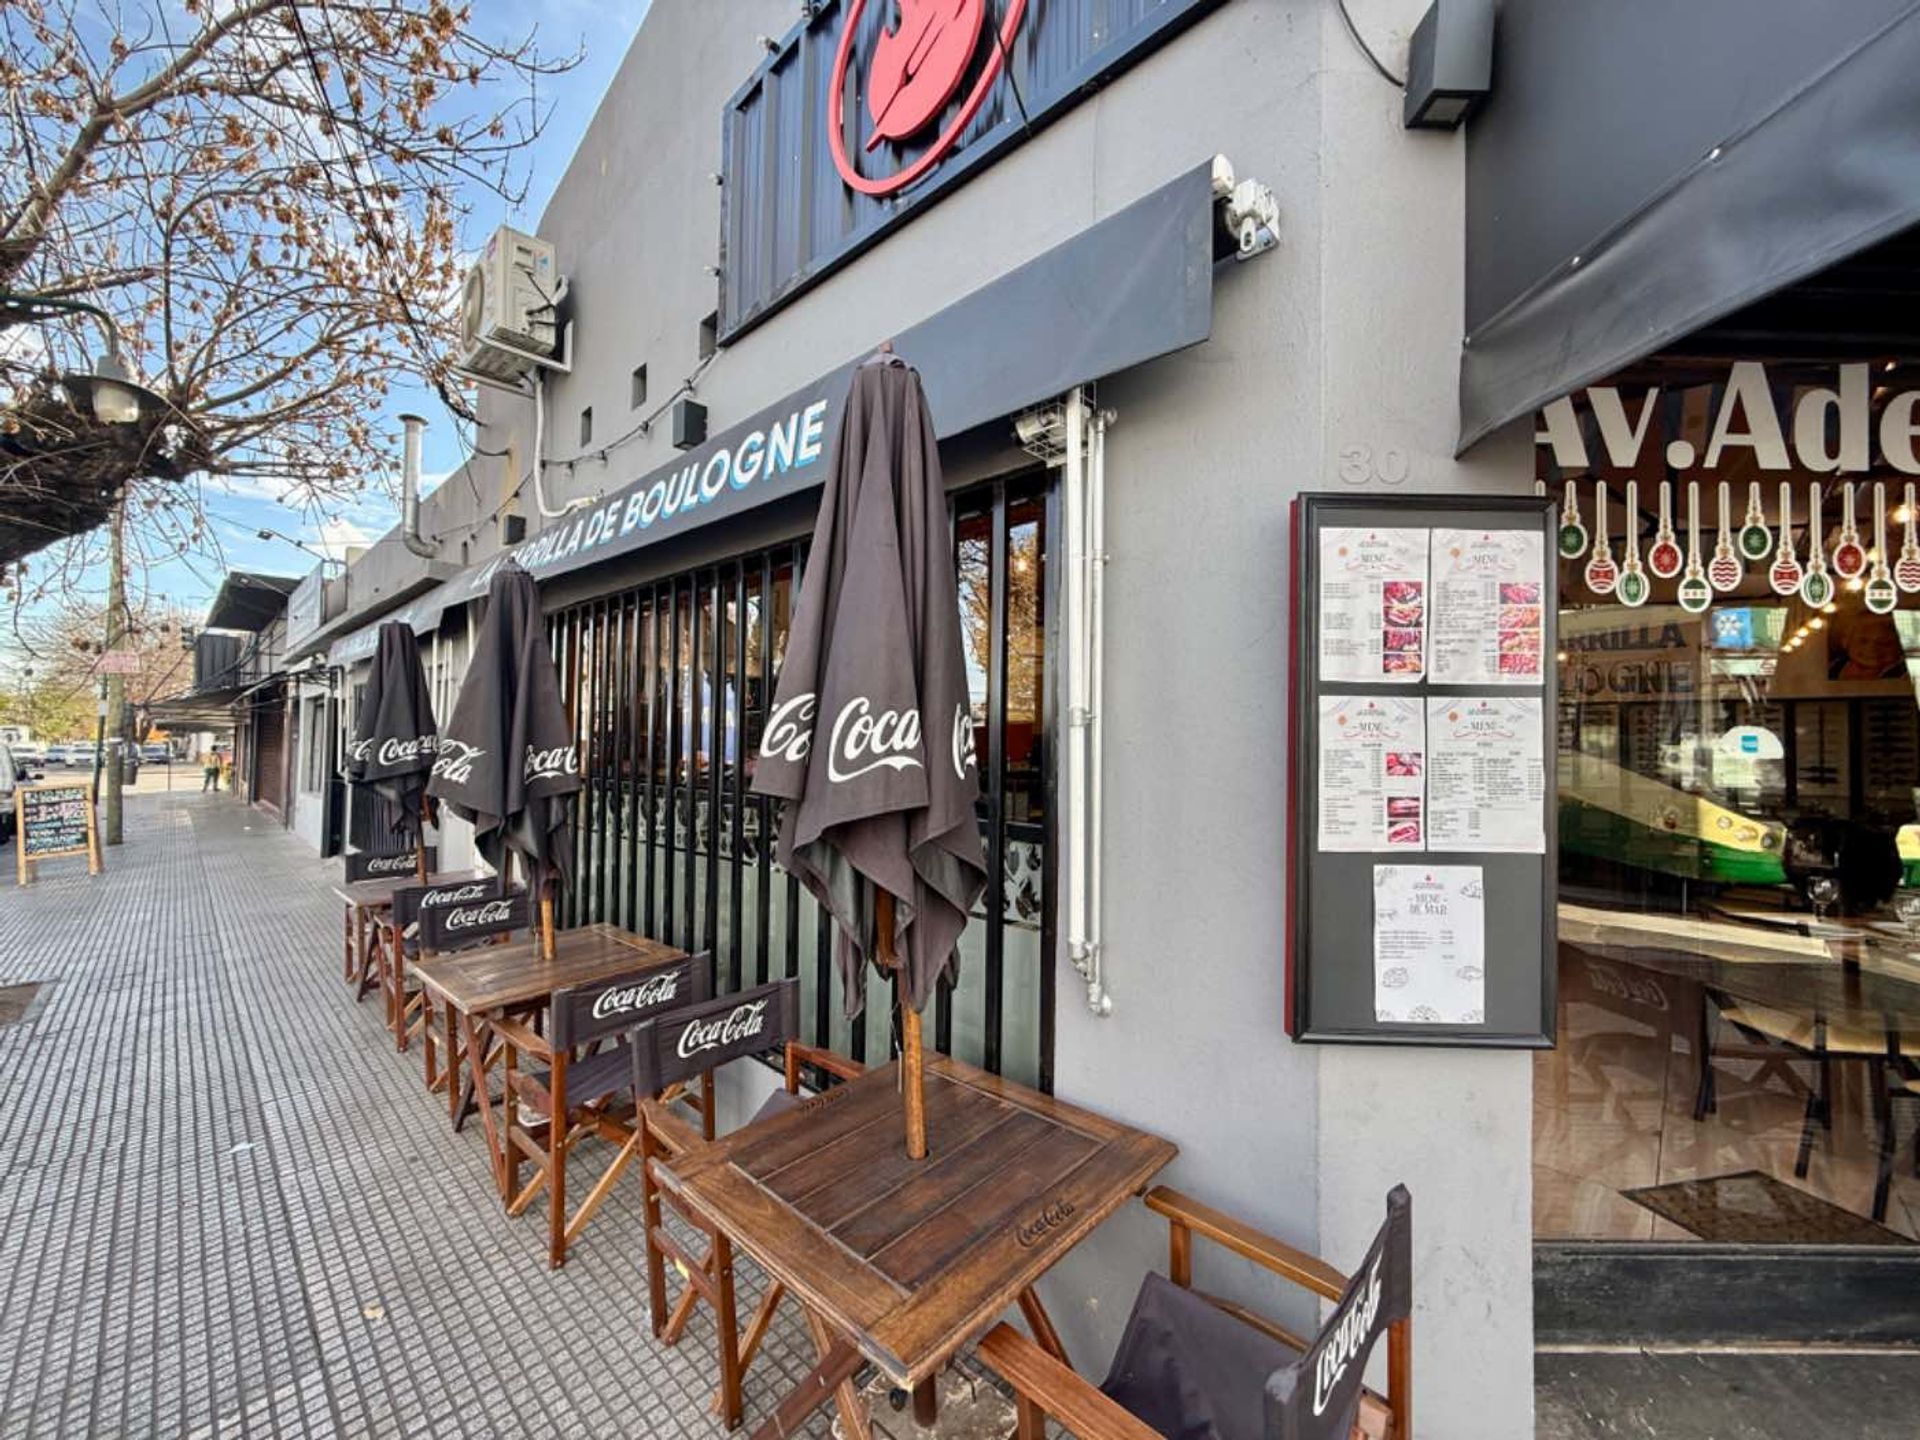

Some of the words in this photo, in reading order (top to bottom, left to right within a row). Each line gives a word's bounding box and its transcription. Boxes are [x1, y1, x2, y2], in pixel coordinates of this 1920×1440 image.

[580, 499, 624, 549] DE
[618, 399, 828, 538] BOULOGNE
[1339, 441, 1408, 486] 30
